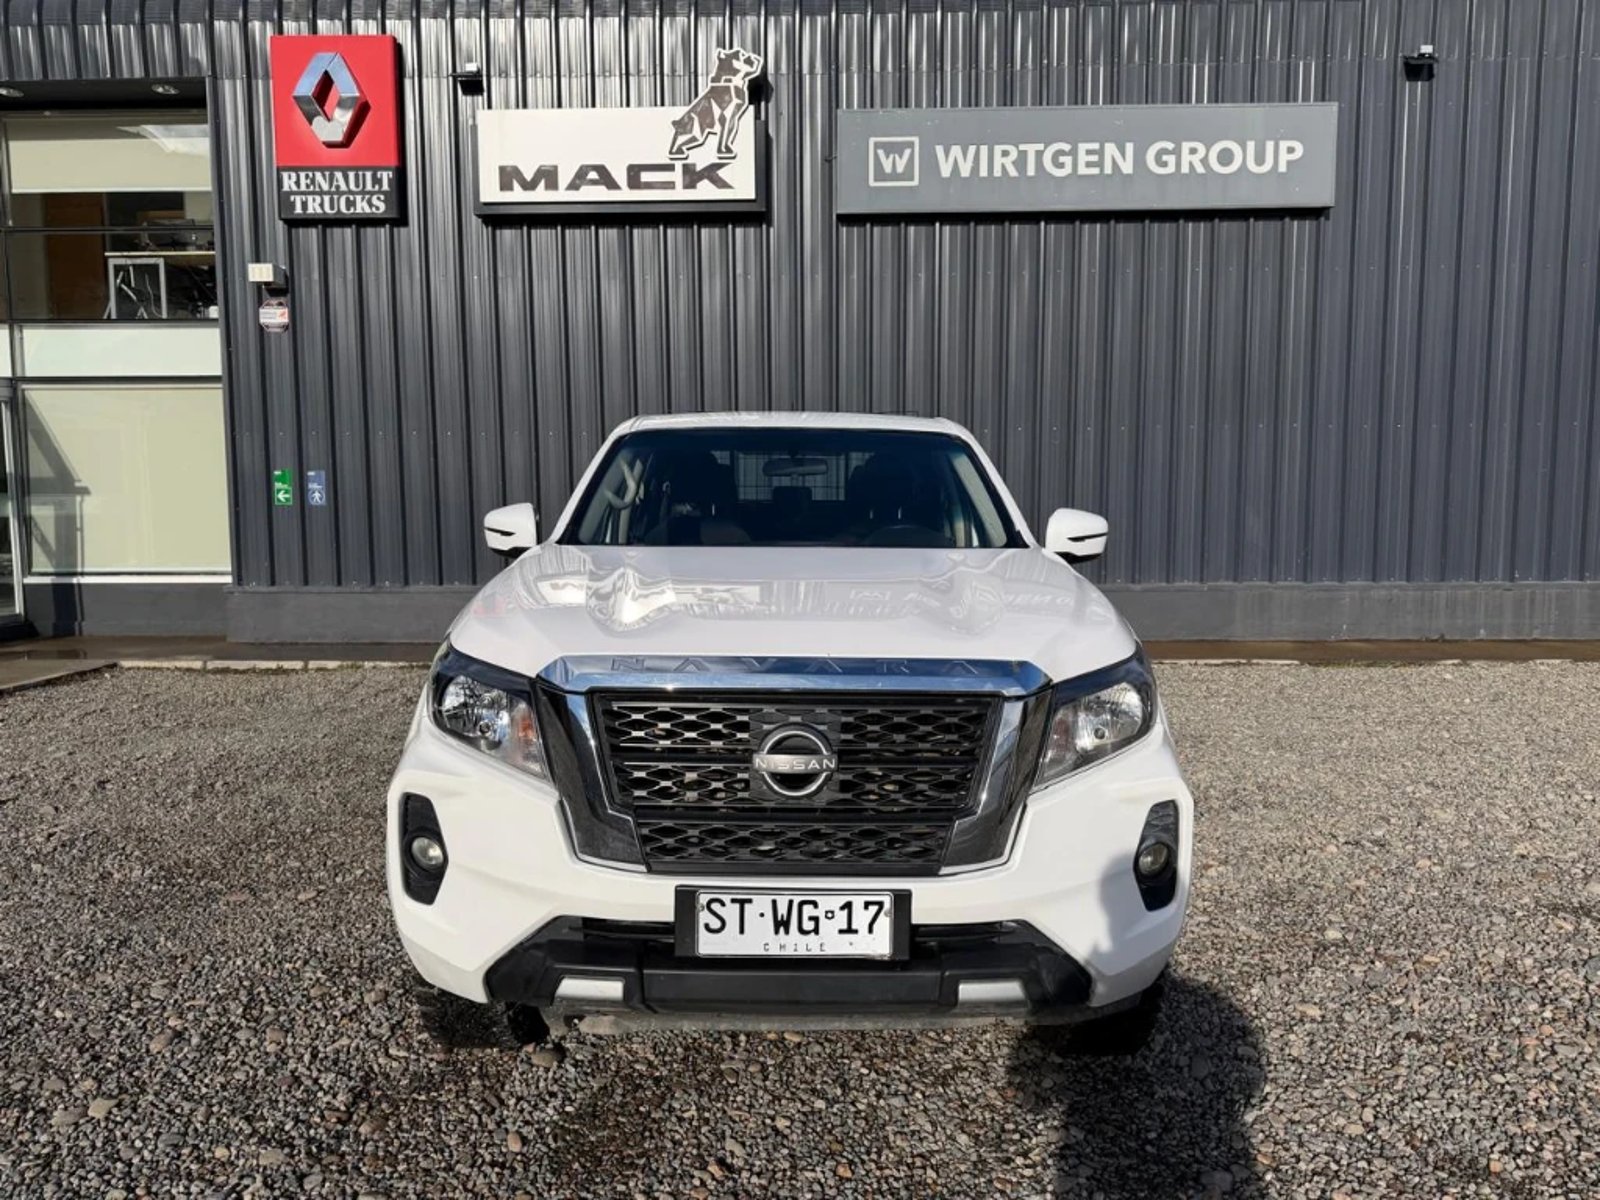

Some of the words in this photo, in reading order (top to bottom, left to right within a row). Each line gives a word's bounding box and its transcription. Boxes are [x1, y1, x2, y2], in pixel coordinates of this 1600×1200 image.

[935, 142, 1134, 178] WIRTGEN
[1145, 139, 1305, 175] GROUP
[280, 170, 393, 192] RENAULT
[498, 161, 735, 192] MACK
[290, 194, 386, 214] TRUCKS
[610, 656, 980, 676] NAVARA
[755, 758, 836, 771] NISSAN
[763, 942, 827, 953] CHILE
